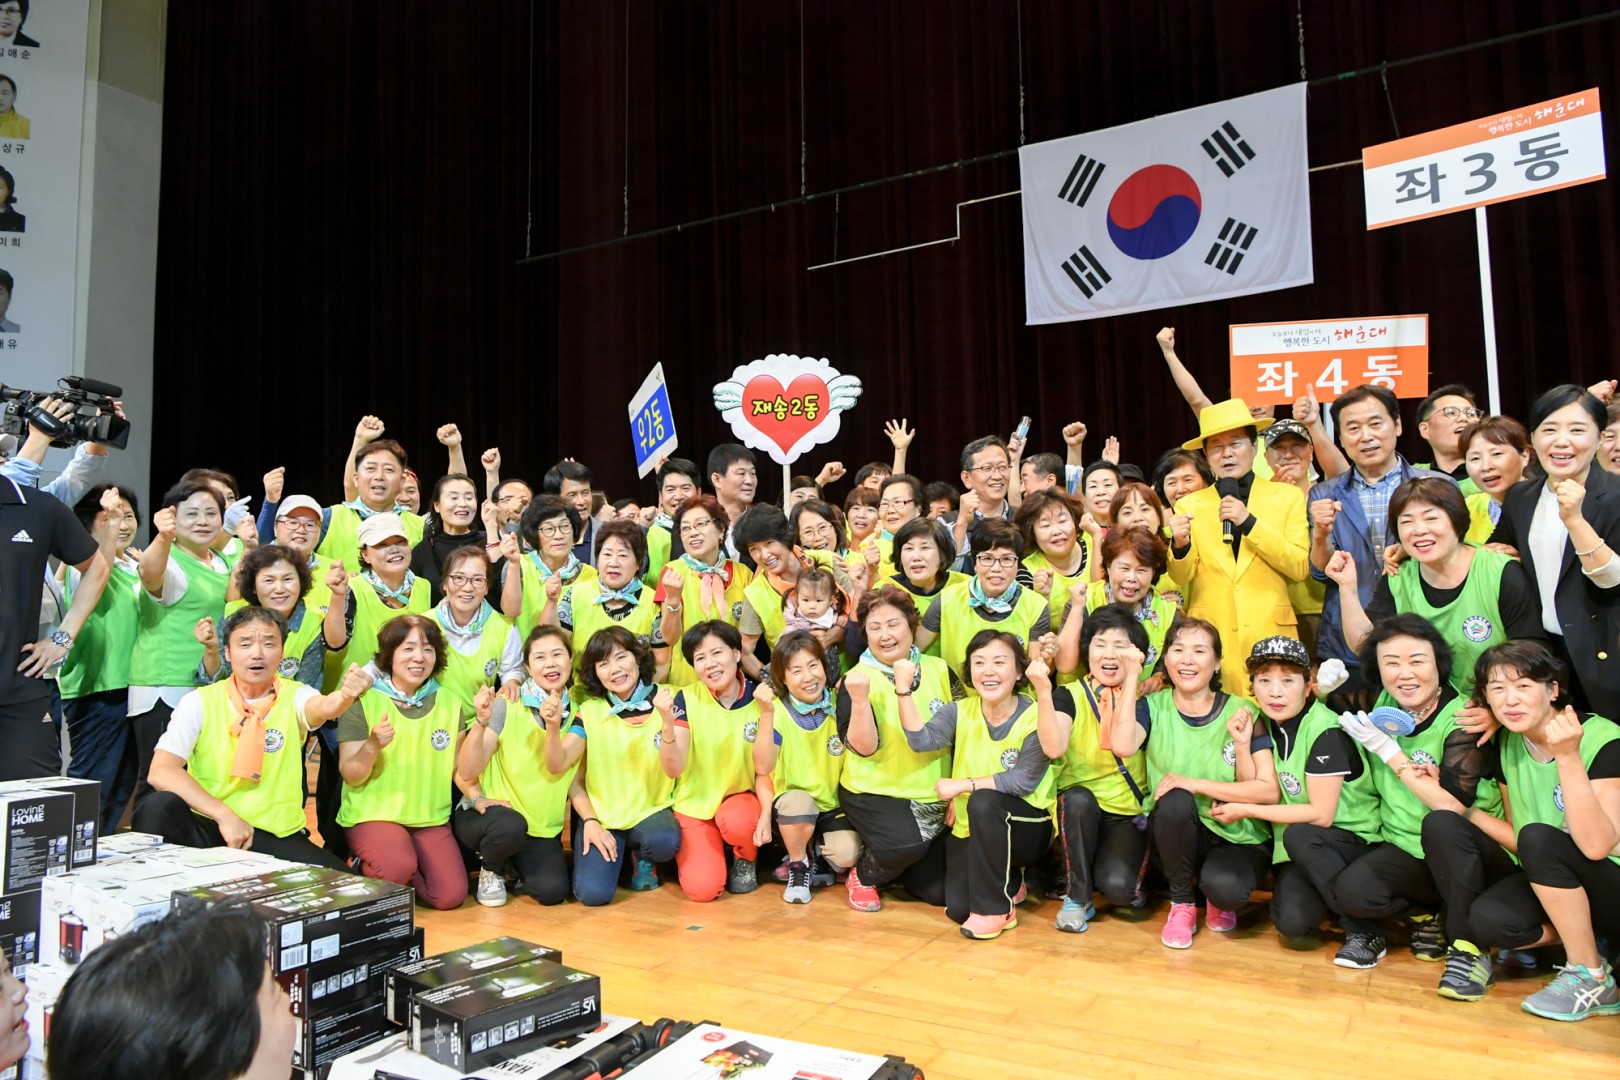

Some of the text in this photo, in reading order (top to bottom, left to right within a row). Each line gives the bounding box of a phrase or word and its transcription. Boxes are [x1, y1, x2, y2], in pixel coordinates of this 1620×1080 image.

[1534, 97, 1586, 119] 해운대
[1283, 335, 1330, 348] 행복한 도시
[1334, 324, 1388, 344] 해운대
[752, 394, 820, 421] 재송2동
[637, 398, 665, 456] 우2동
[11, 813, 45, 826] HOME
[12, 804, 45, 817] Loving
[581, 998, 596, 1016] VS
